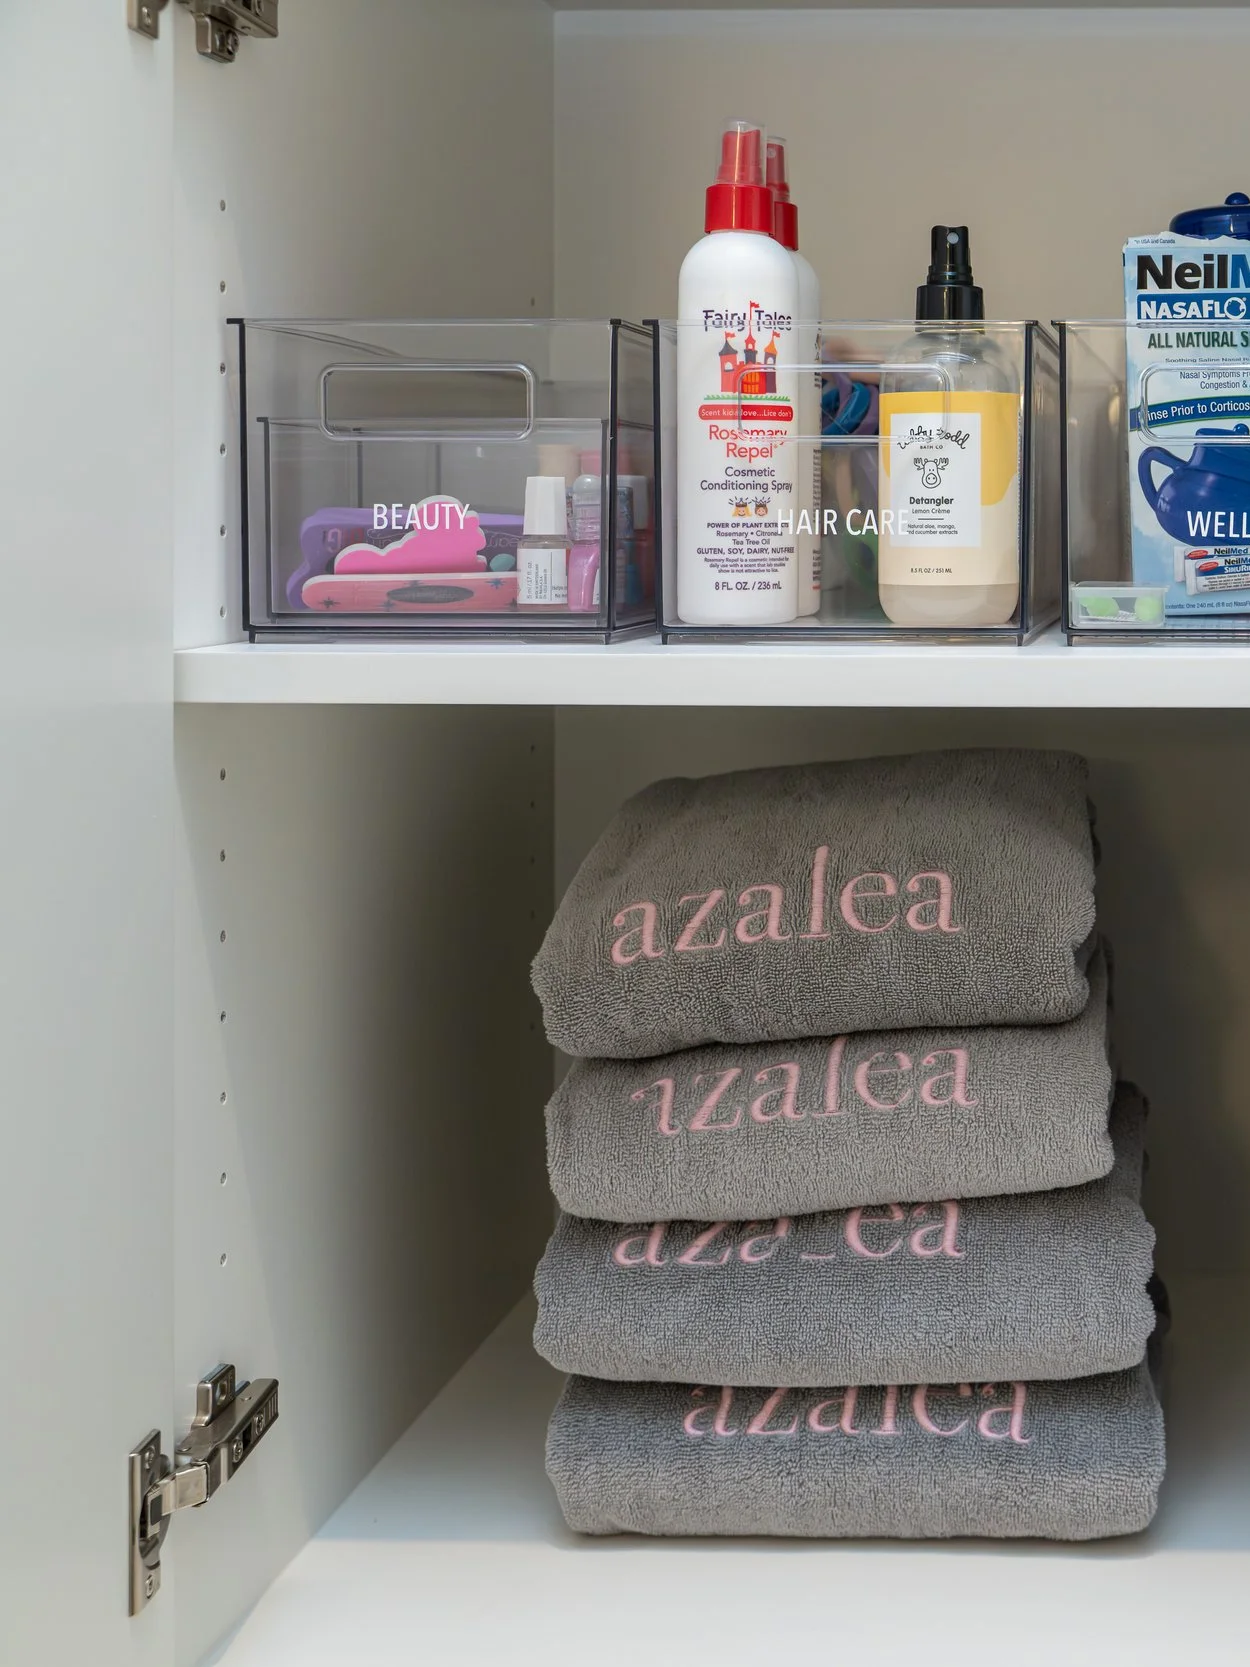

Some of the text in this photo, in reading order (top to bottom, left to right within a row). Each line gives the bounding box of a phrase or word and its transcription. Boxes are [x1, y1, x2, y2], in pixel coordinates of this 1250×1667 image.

[702, 309, 793, 332] Fairy Tales
[1148, 331, 1173, 349] ALL
[1176, 331, 1238, 349] NATURAL
[1179, 371, 1241, 380] Nasal Symptoms
[1199, 381, 1240, 391] Congestion
[1242, 380, 1248, 388] &
[701, 409, 721, 417] Scent
[1171, 404, 1194, 416] Prior
[1197, 403, 1208, 413] to
[724, 466, 776, 477] Cosmetic
[700, 480, 793, 493] Conditioning Spray
[909, 496, 955, 507] Detangler
[373, 503, 471, 531] BEAUTY
[777, 508, 910, 536] HAIR CARE
[716, 530, 749, 538] Rosemary
[696, 547, 726, 555] GLUTEN,
[727, 547, 745, 555] SOY,
[746, 547, 770, 555] DAIRY,
[1213, 547, 1249, 555] NeilMed
[714, 581, 719, 591] 8
[721, 581, 733, 591] FL.
[735, 581, 750, 591] OZ.
[757, 581, 771, 590] 236
[610, 845, 963, 967] azalea
[612, 1199, 967, 1266] azaea
